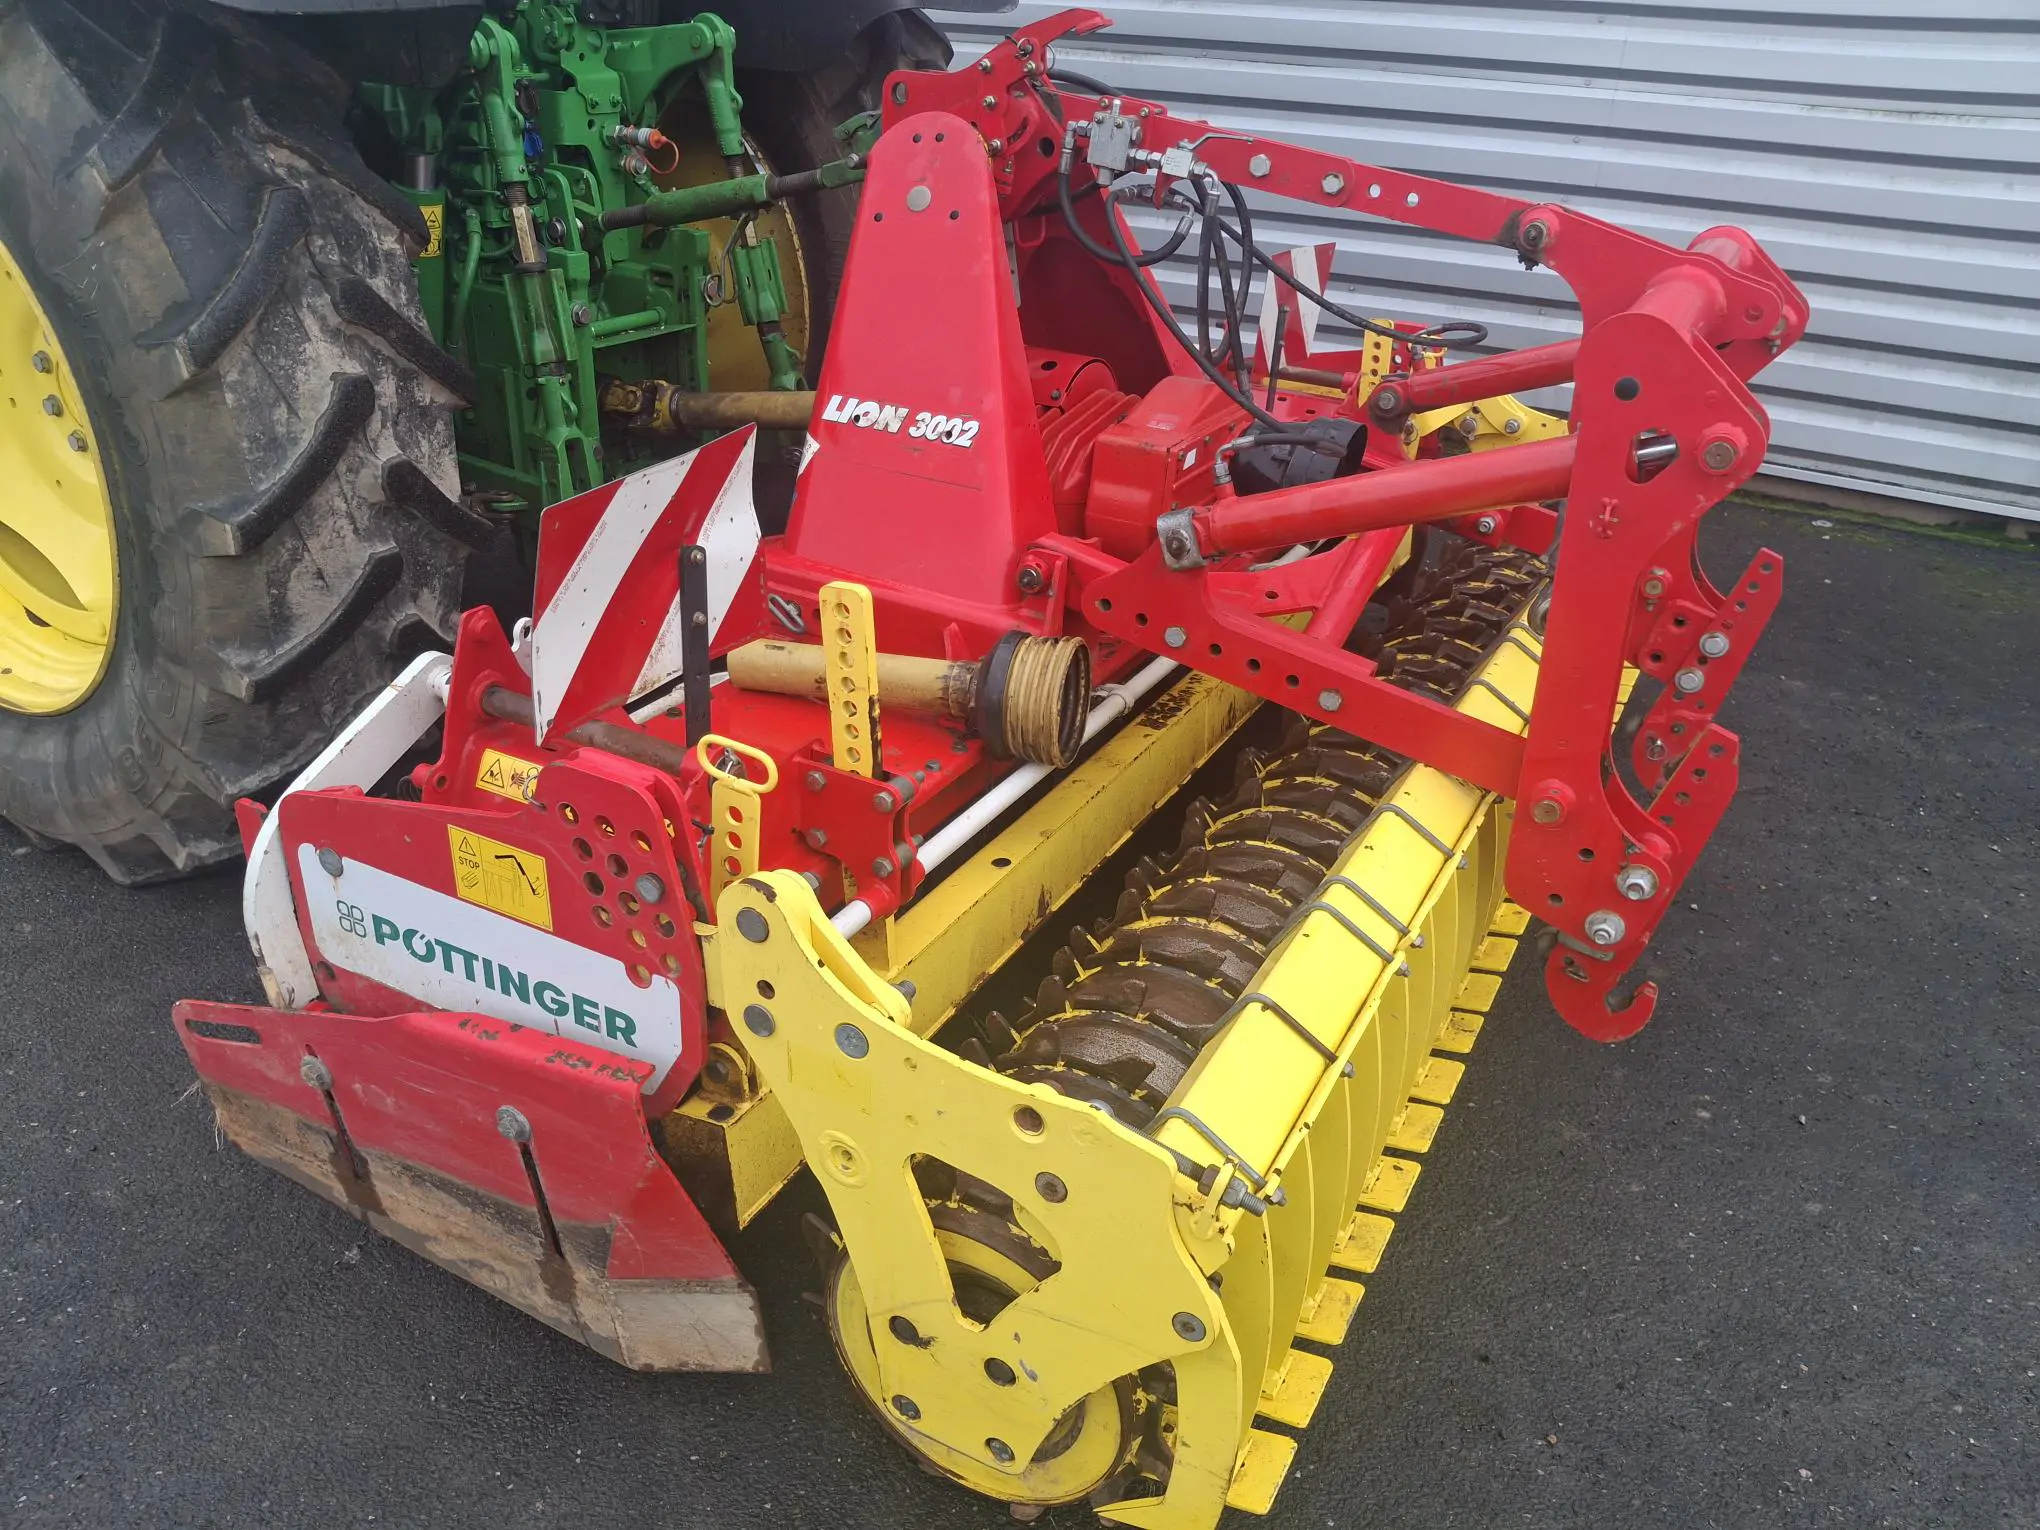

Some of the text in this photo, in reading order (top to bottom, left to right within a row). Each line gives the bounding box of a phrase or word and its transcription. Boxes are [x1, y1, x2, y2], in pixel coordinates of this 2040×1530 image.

[821, 394, 980, 448] LION 3002
[458, 855, 480, 870] STOP
